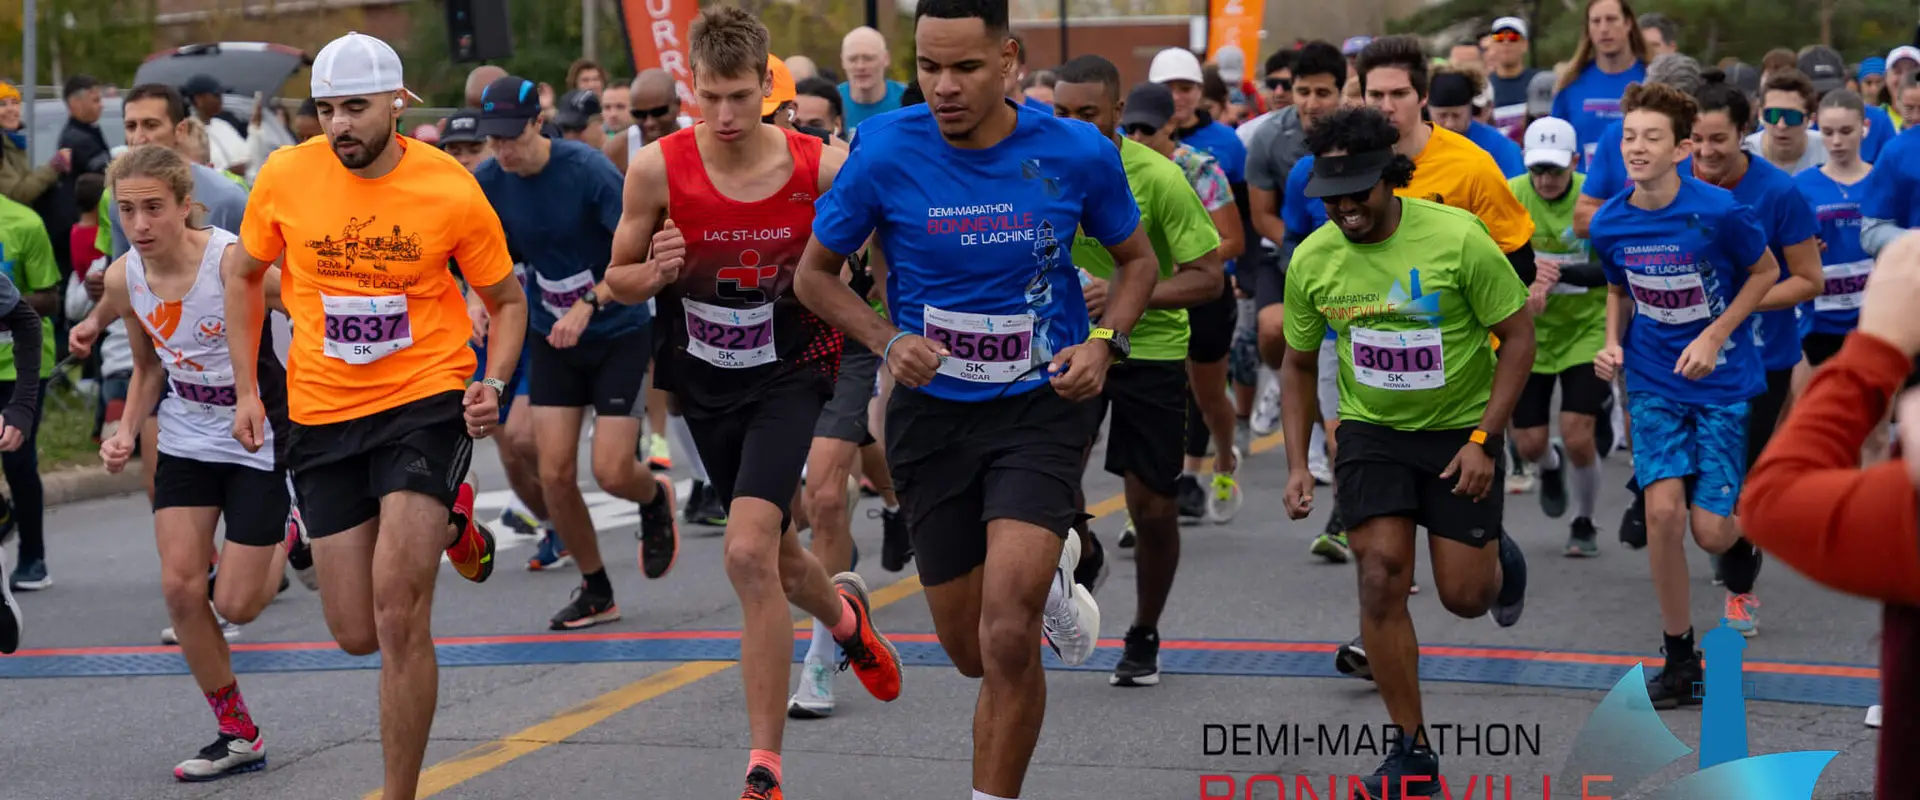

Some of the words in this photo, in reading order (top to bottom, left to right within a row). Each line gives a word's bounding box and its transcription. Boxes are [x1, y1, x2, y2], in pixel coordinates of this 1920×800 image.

[928, 203, 1014, 217] DEMI-MARATHON
[927, 212, 1034, 235] BONNEVILLE
[704, 230, 730, 241] LAC
[732, 227, 792, 241] ST-LOUIS
[961, 233, 977, 246] DE
[981, 229, 1035, 244] LACHINE
[1624, 244, 1680, 254] DEMI-MARATHON
[317, 268, 371, 279] MARATHON
[1645, 265, 1658, 275] DE
[1658, 263, 1696, 274] LACHINE
[358, 279, 371, 288] DE
[1635, 287, 1696, 309] 3207
[326, 315, 403, 342] 3637
[693, 317, 766, 350] 3227
[353, 345, 372, 355] 5K
[934, 329, 1022, 361] 3560
[718, 351, 736, 360] 5K
[1360, 346, 1433, 371] 3010
[965, 363, 986, 373] 5K
[960, 372, 990, 380] OSCAR
[1387, 374, 1404, 382] 5K
